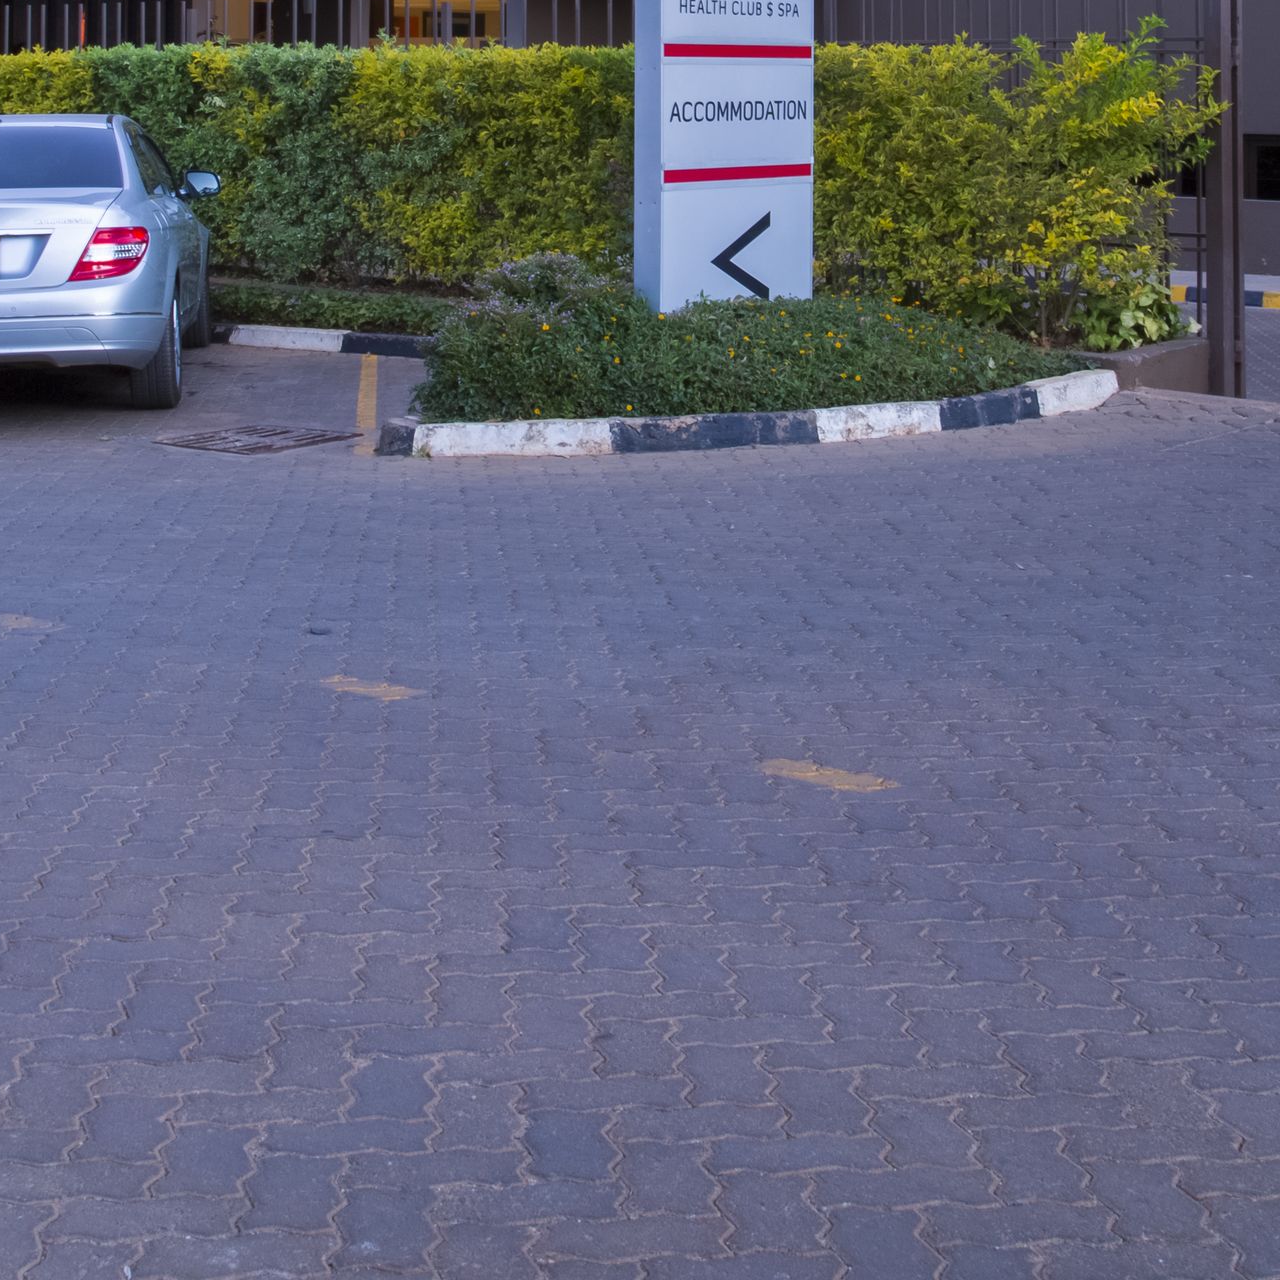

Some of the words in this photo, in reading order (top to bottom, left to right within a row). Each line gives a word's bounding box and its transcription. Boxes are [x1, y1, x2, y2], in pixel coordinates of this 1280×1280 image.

[731, 1, 762, 16] CLUB
[778, 2, 800, 18] SPA
[669, 100, 807, 123] ACCOMMODATION
